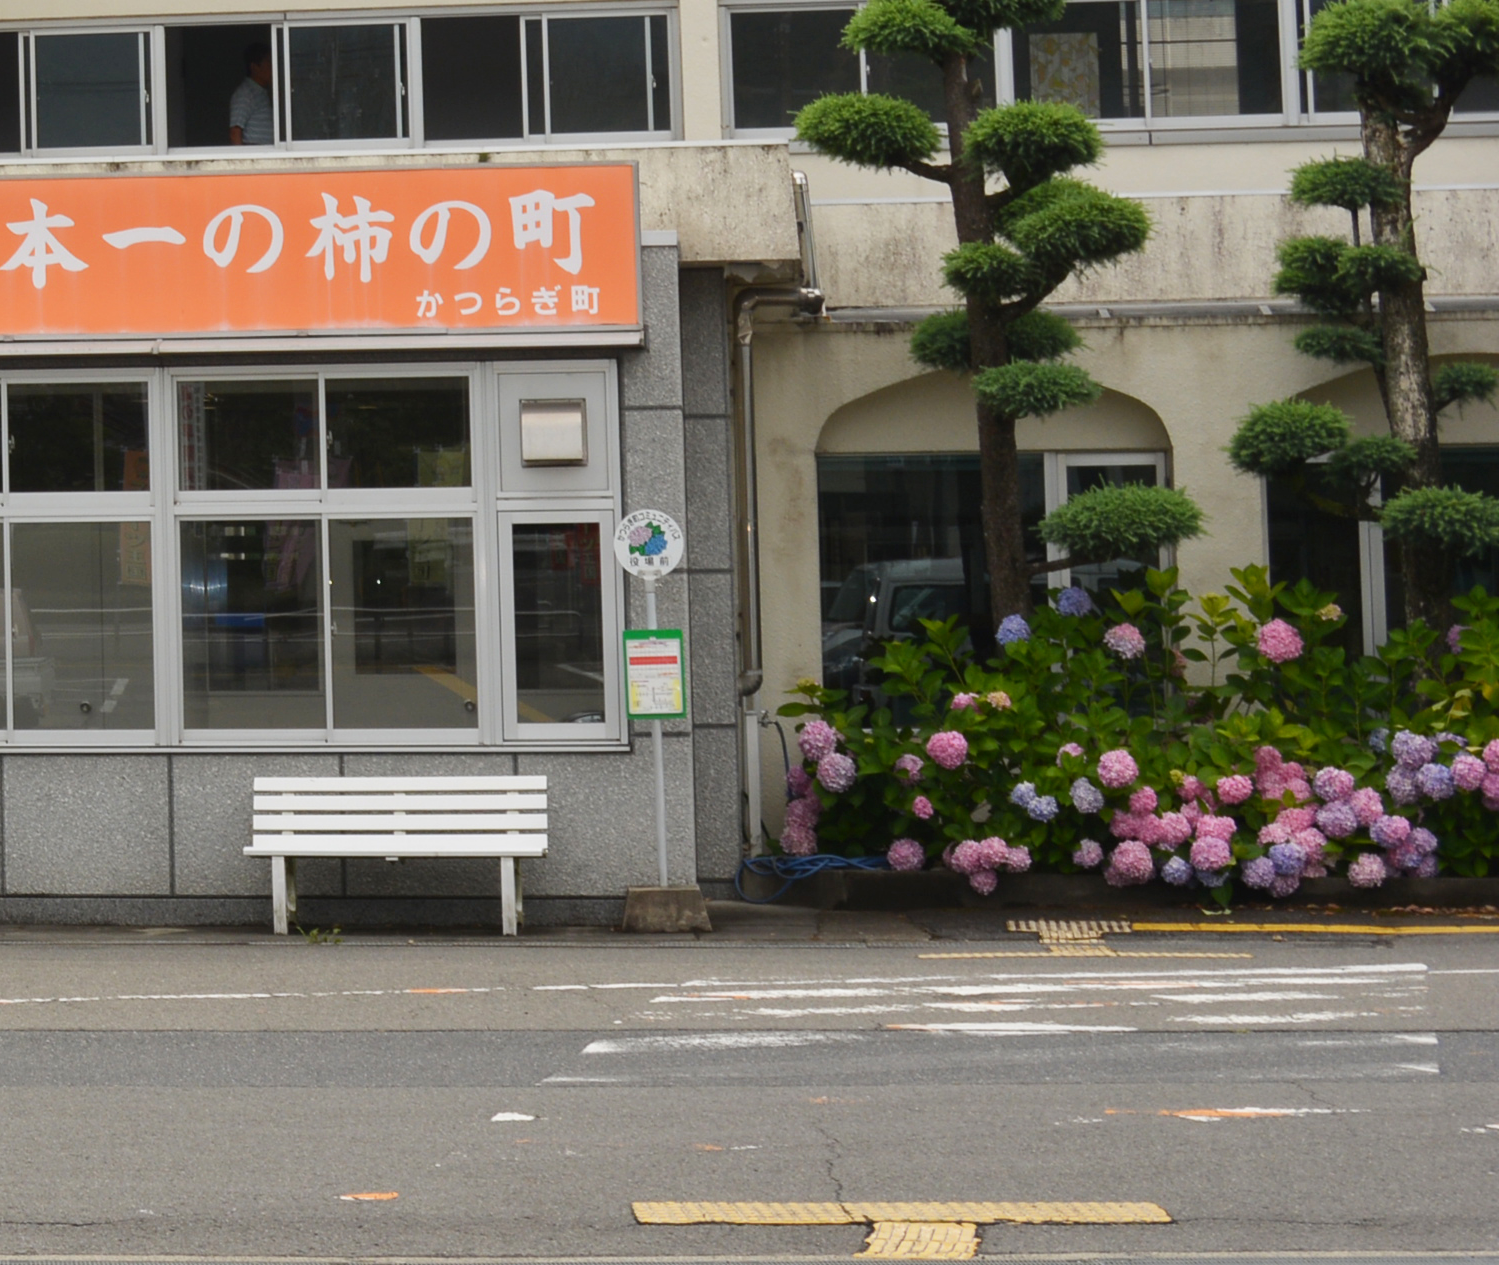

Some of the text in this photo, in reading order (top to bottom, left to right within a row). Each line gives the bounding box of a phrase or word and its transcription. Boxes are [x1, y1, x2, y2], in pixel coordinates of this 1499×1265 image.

[416, 285, 600, 318] かつらぎ町
[629, 556, 669, 567] 役場前
